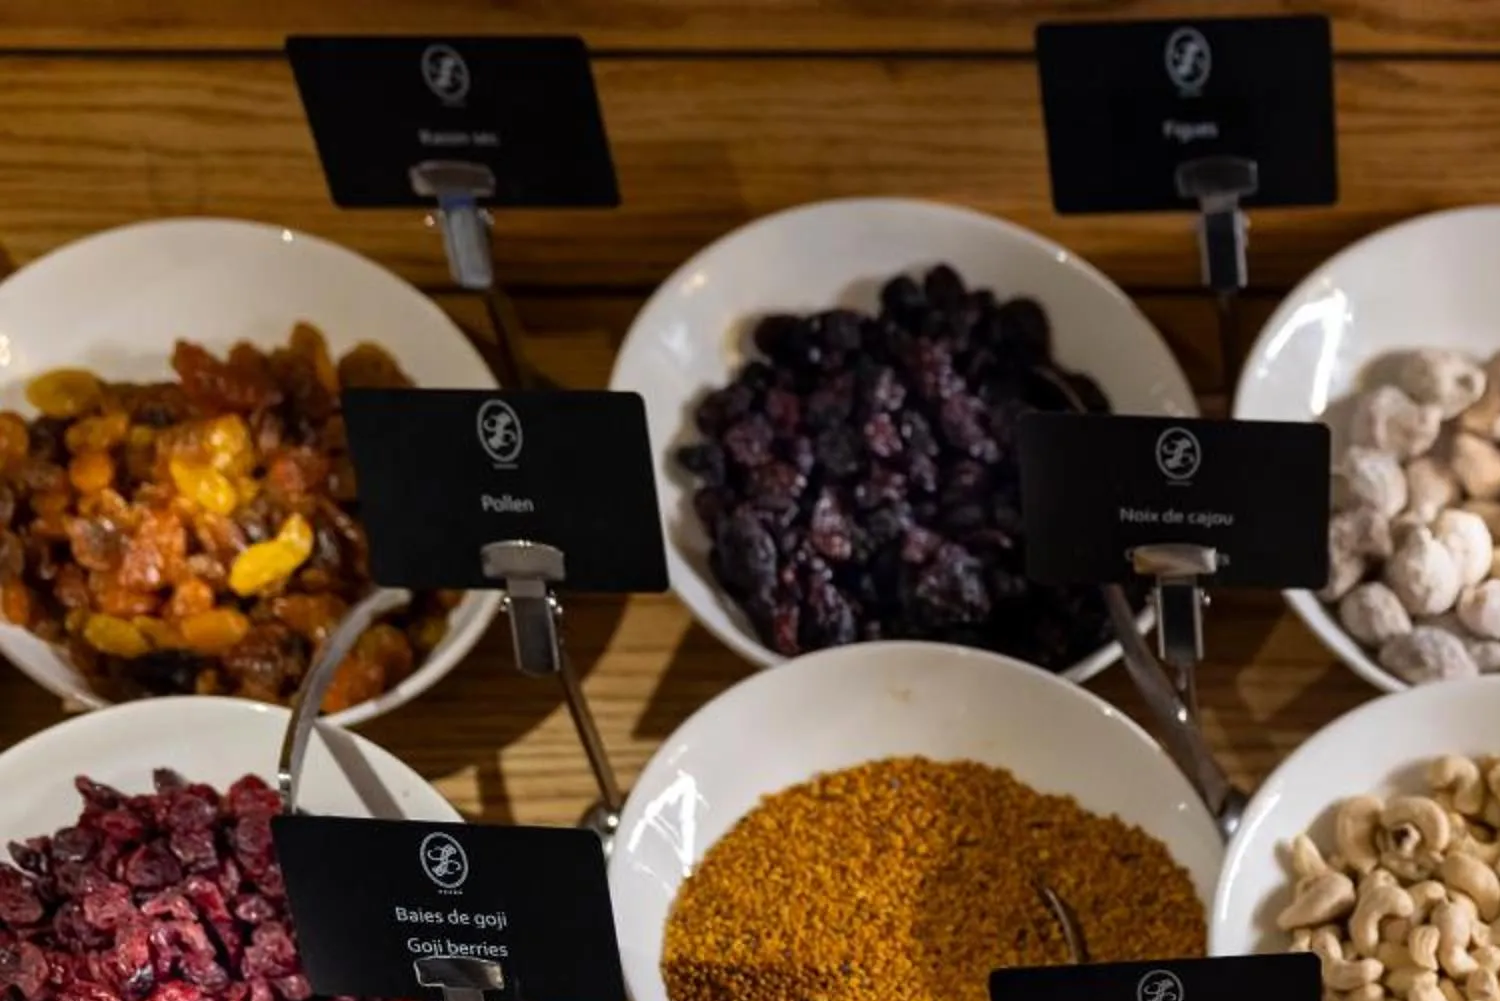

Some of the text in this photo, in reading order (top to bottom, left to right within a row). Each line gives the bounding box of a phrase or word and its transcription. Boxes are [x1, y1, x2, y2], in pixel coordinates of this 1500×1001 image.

[480, 494, 534, 512] Pollen
[1119, 507, 1234, 528] Noix de cajou
[395, 906, 508, 931] Baies de goji
[407, 937, 509, 958] Goji berries
